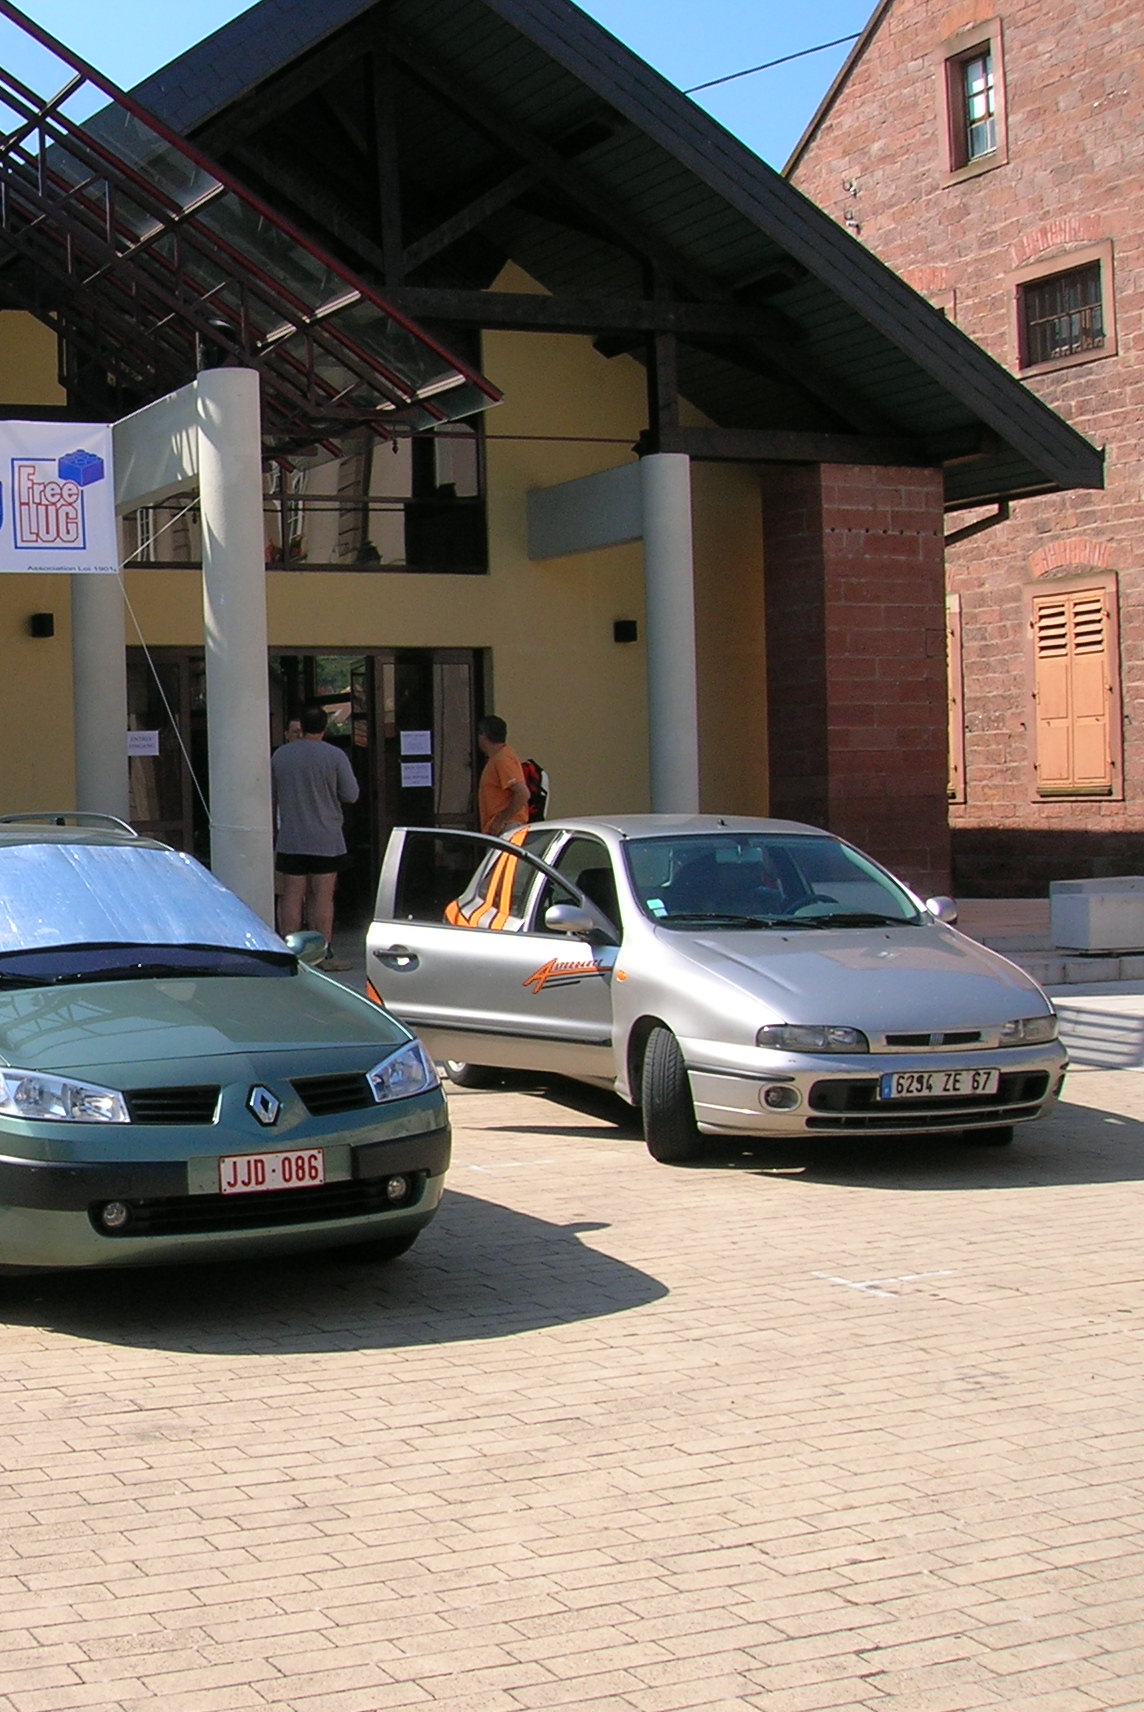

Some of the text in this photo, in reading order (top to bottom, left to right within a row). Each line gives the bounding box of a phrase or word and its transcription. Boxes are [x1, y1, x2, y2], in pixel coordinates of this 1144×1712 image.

[18, 465, 80, 505] Free
[19, 502, 79, 543] LUG
[896, 1071, 992, 1094] 6294 ZE 67
[227, 1154, 318, 1187] JJD 086
